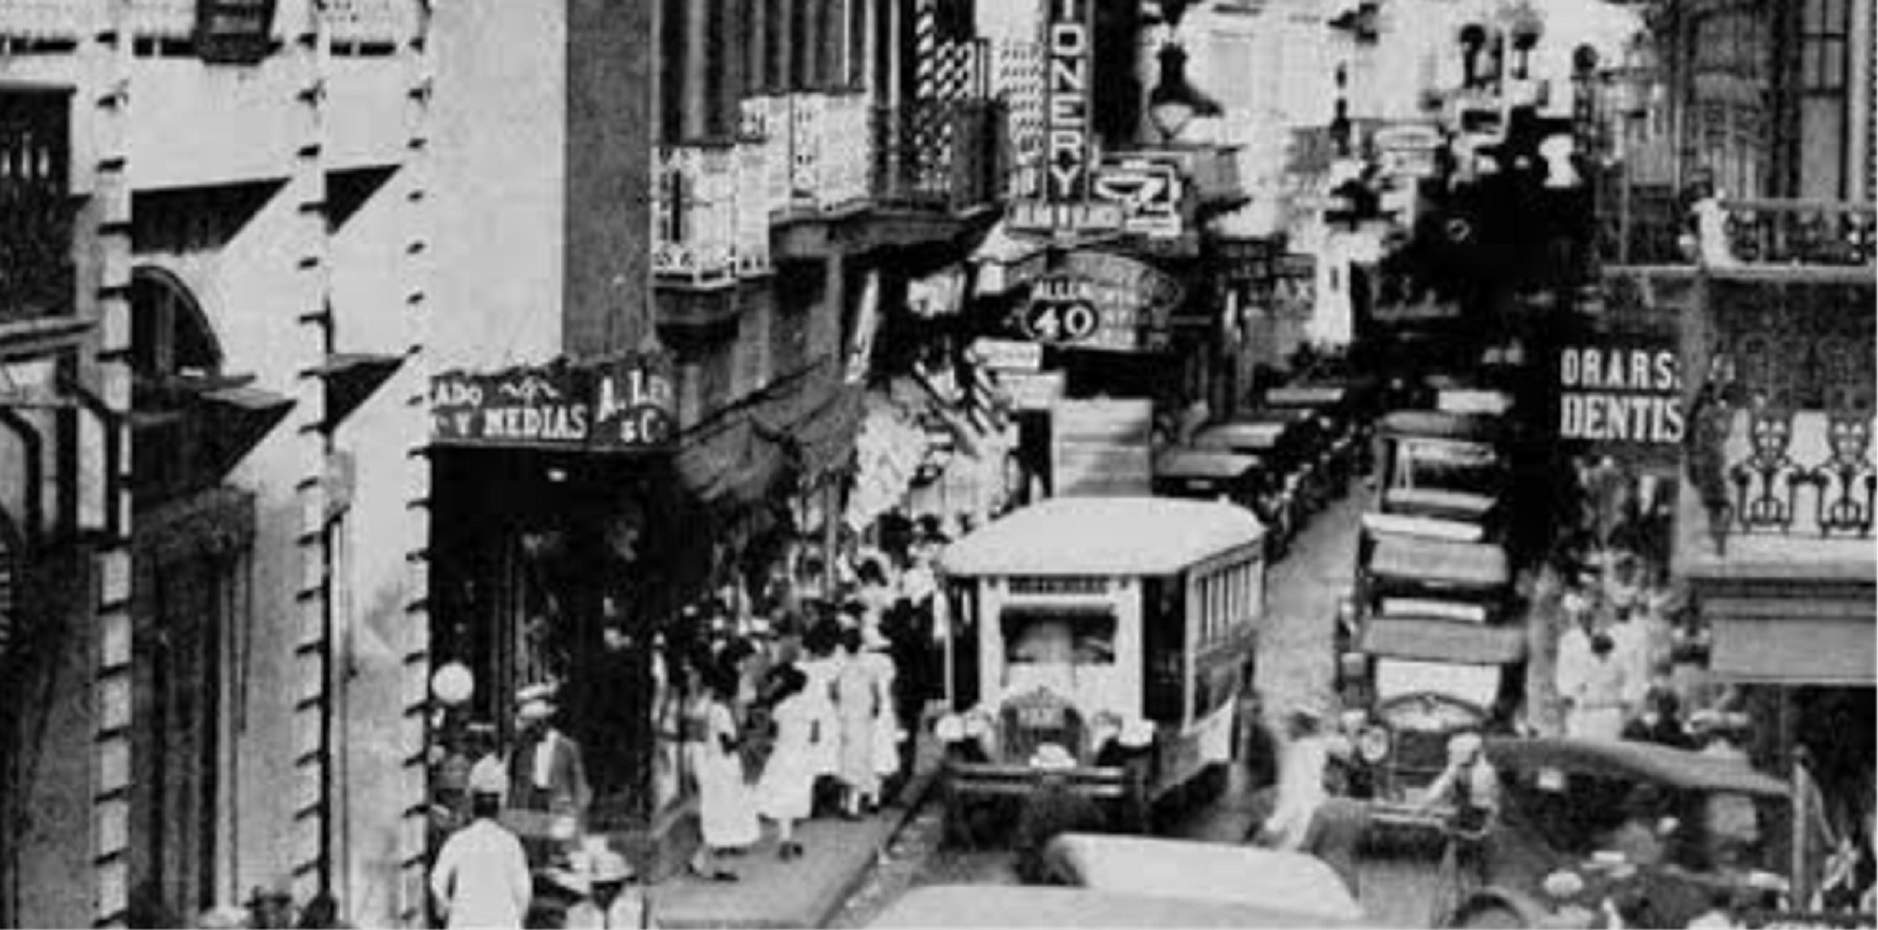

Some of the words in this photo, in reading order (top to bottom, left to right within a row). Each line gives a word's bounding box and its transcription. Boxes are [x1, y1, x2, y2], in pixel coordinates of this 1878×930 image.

[1033, 304, 1094, 338] 40
[482, 404, 588, 440] MEDIAS
[1560, 393, 1684, 442] DENTIS
